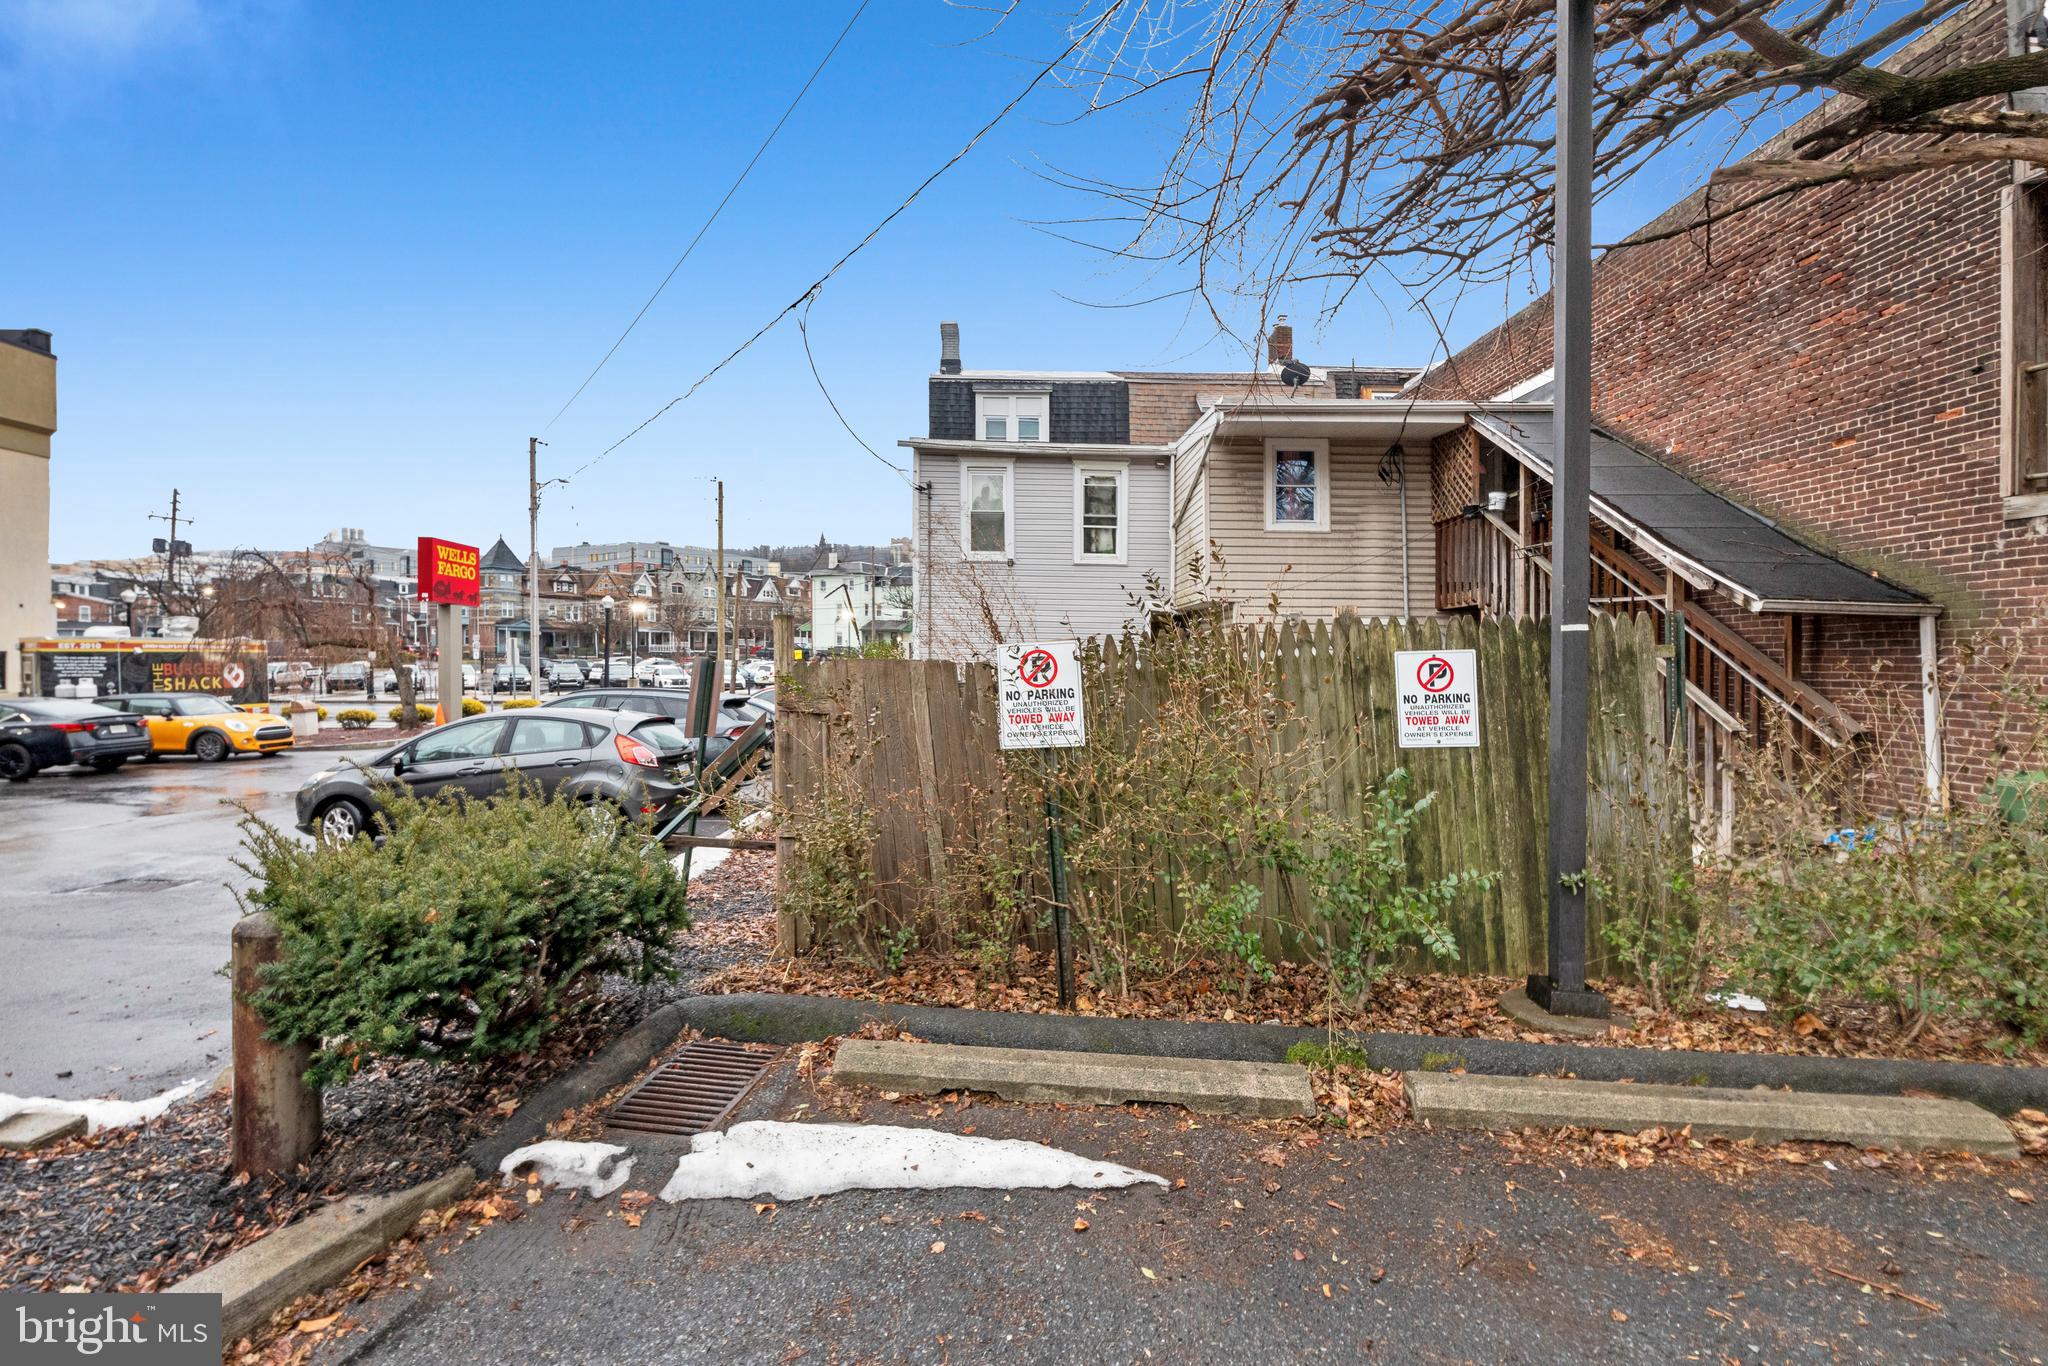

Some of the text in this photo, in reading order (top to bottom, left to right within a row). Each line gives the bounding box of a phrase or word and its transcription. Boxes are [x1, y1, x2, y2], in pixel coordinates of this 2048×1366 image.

[437, 545, 477, 566] WELLS
[437, 561, 476, 581] FARGO
[163, 662, 221, 676] BURGER
[152, 663, 164, 692] THE
[163, 676, 223, 692] SHACK
[1005, 688, 1075, 701] NO PARKING
[1403, 693, 1471, 704] NO PARKING
[1008, 712, 1075, 724] TOWED AWAY
[1405, 715, 1471, 726] TOWED AWAY
